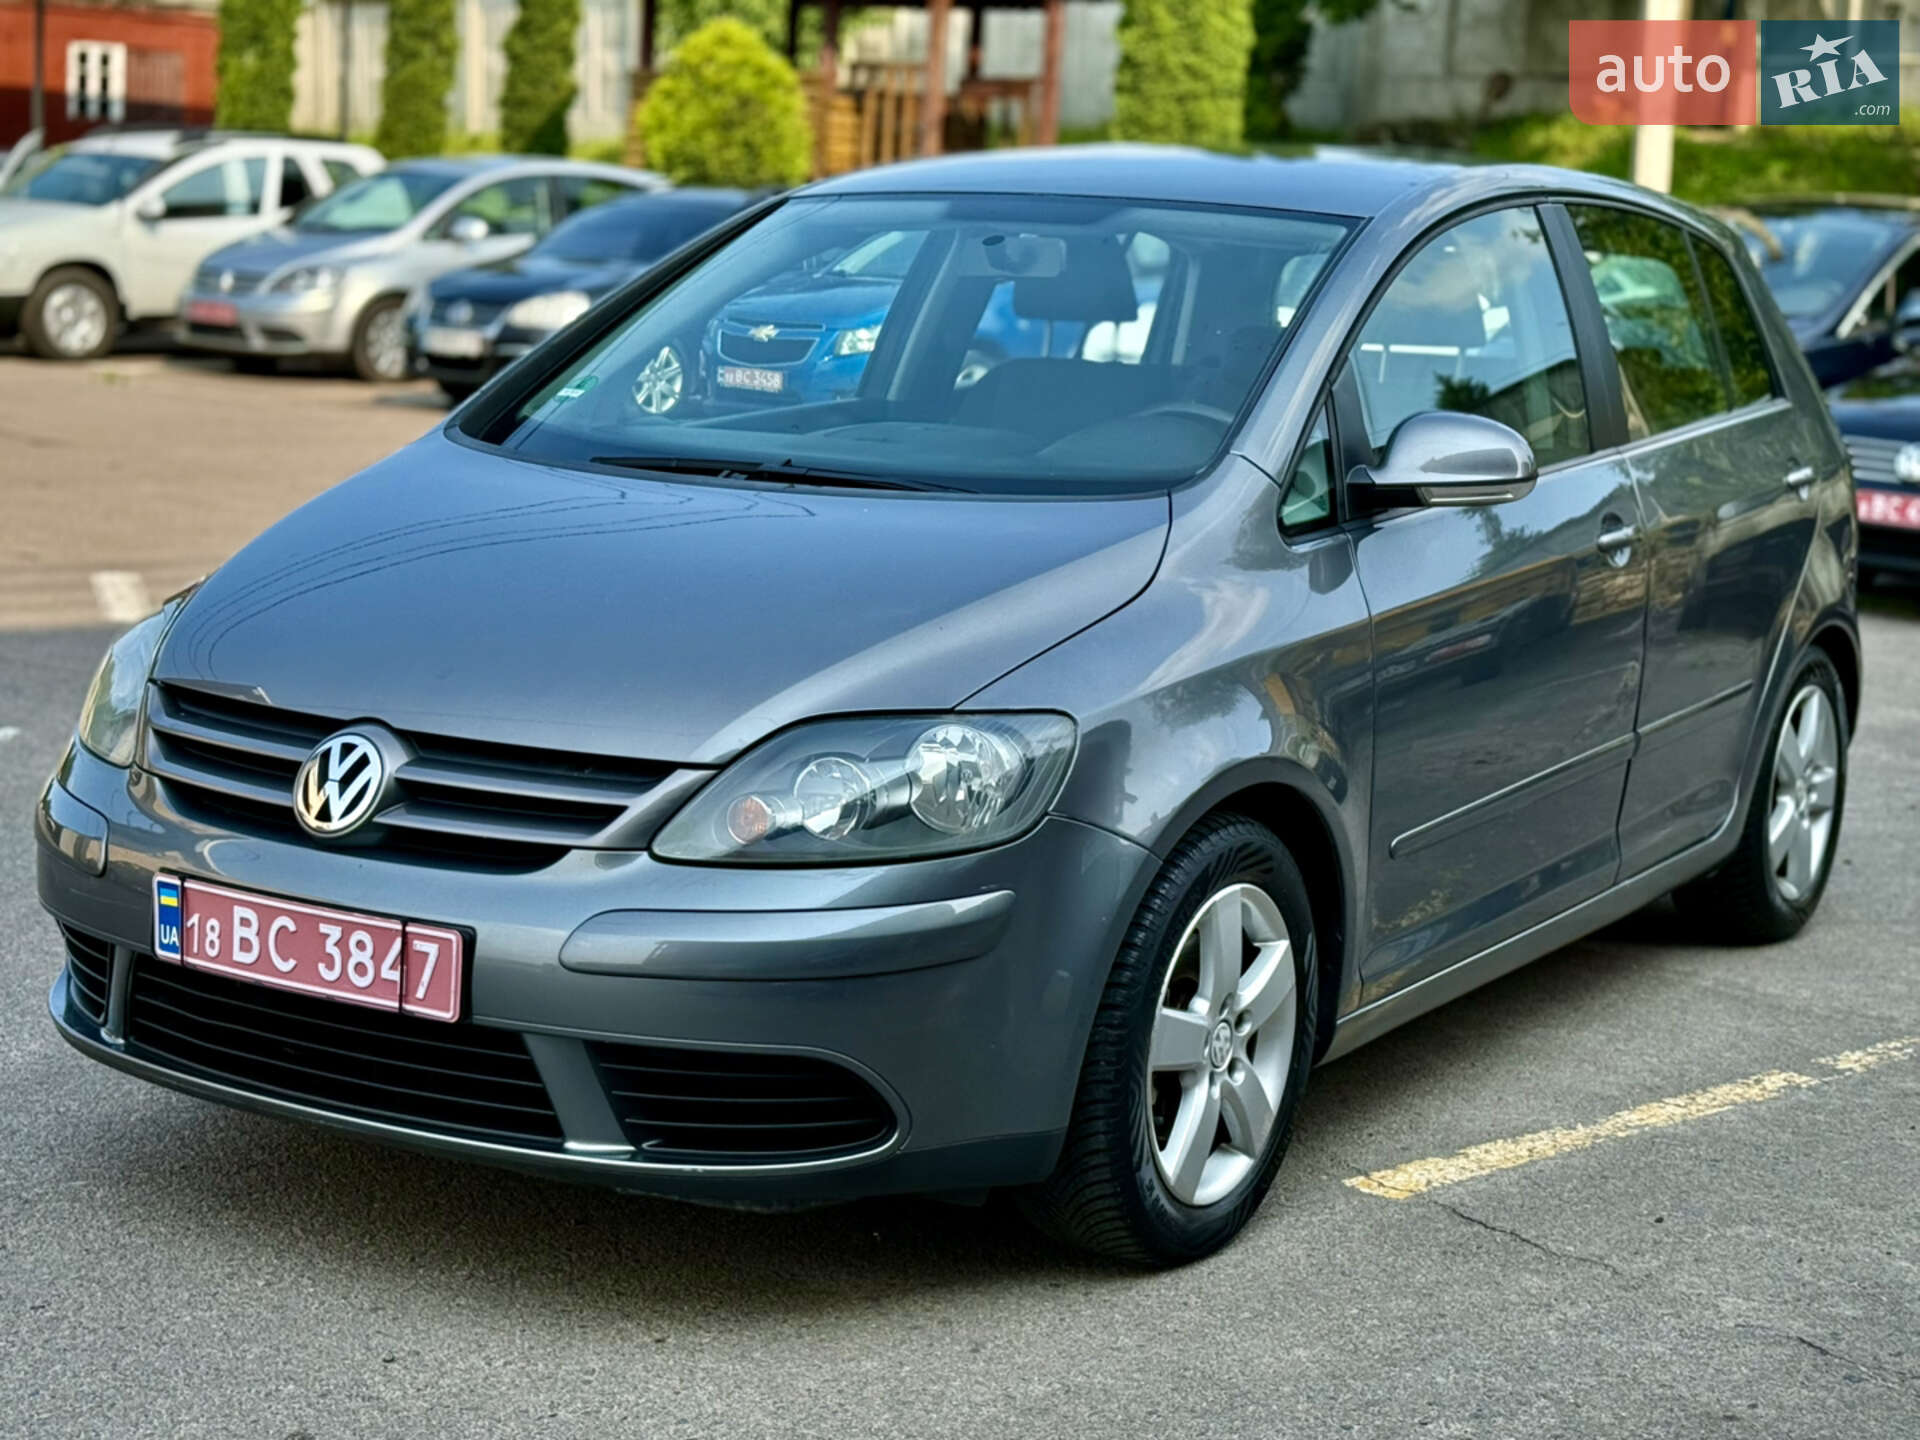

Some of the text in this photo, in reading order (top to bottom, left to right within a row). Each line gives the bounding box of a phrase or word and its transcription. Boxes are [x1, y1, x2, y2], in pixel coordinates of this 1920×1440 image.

[295, 733, 382, 832] VW
[161, 924, 180, 946] UA
[186, 905, 440, 1000] 18 BC 3847
